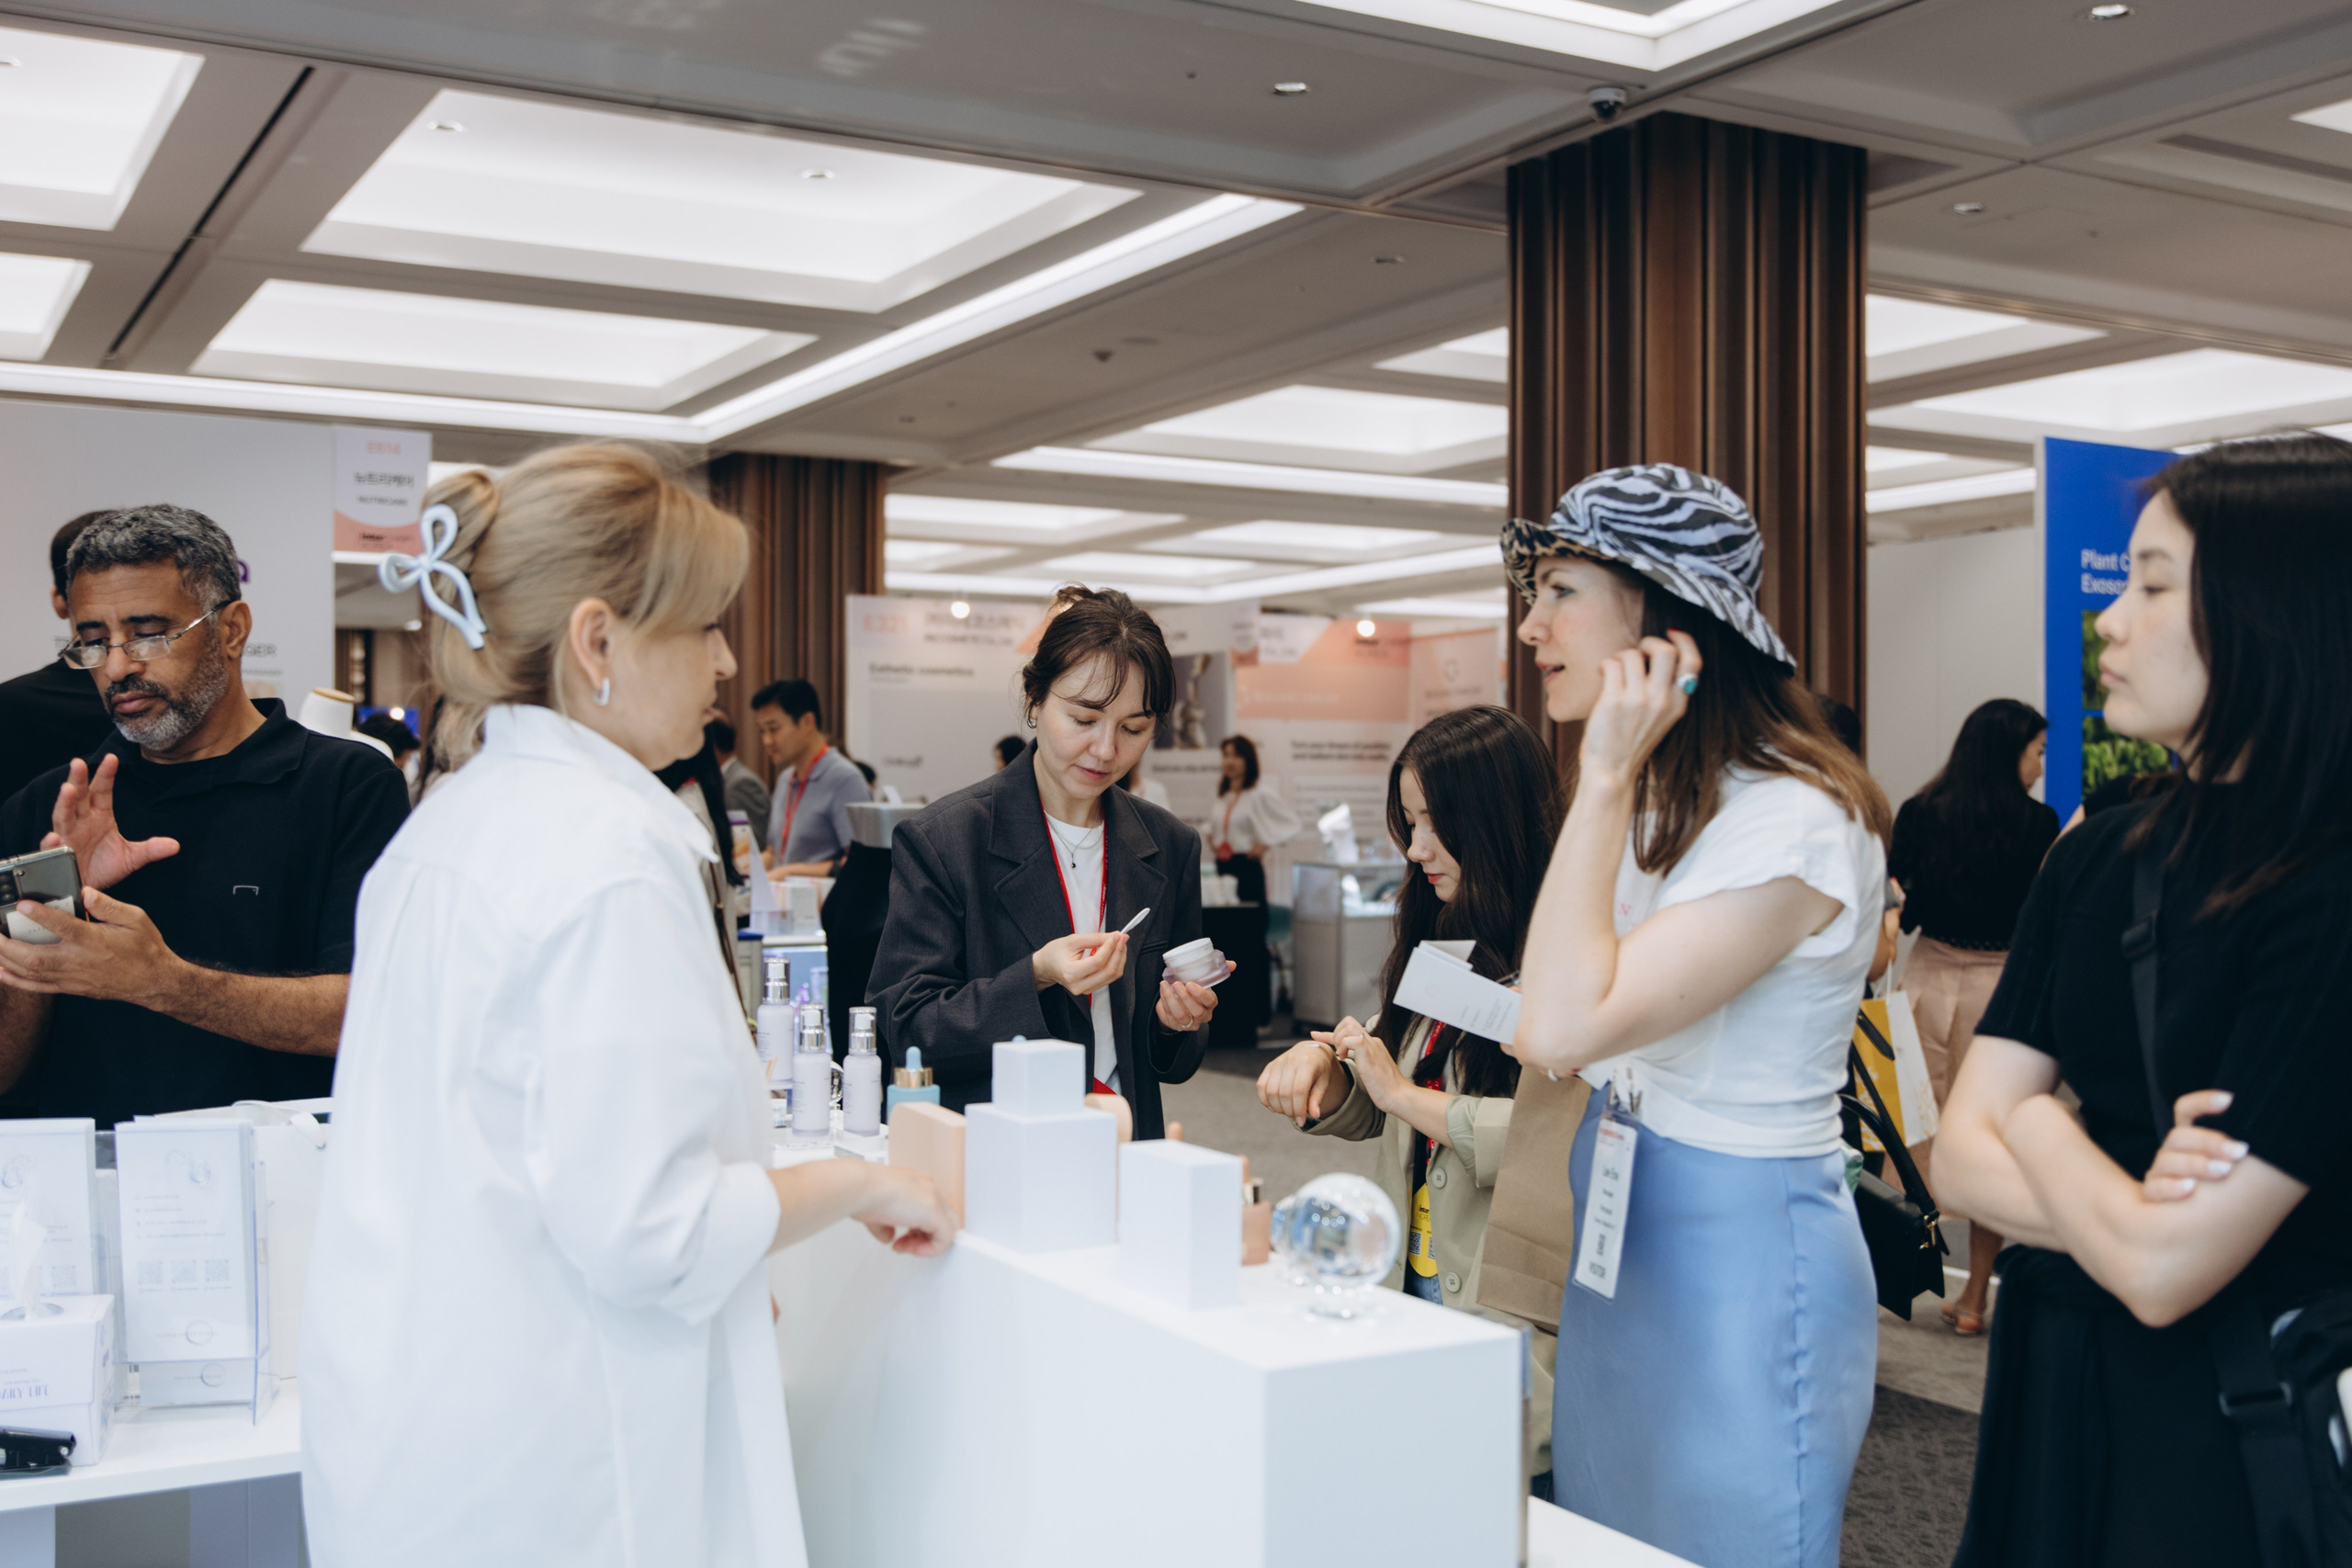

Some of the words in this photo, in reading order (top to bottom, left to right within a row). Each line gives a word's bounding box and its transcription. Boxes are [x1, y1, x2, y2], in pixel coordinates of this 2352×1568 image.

[2081, 549, 2118, 570] Plant
[0, 1387, 22, 1401] AILY
[28, 1384, 50, 1398] LIFE
